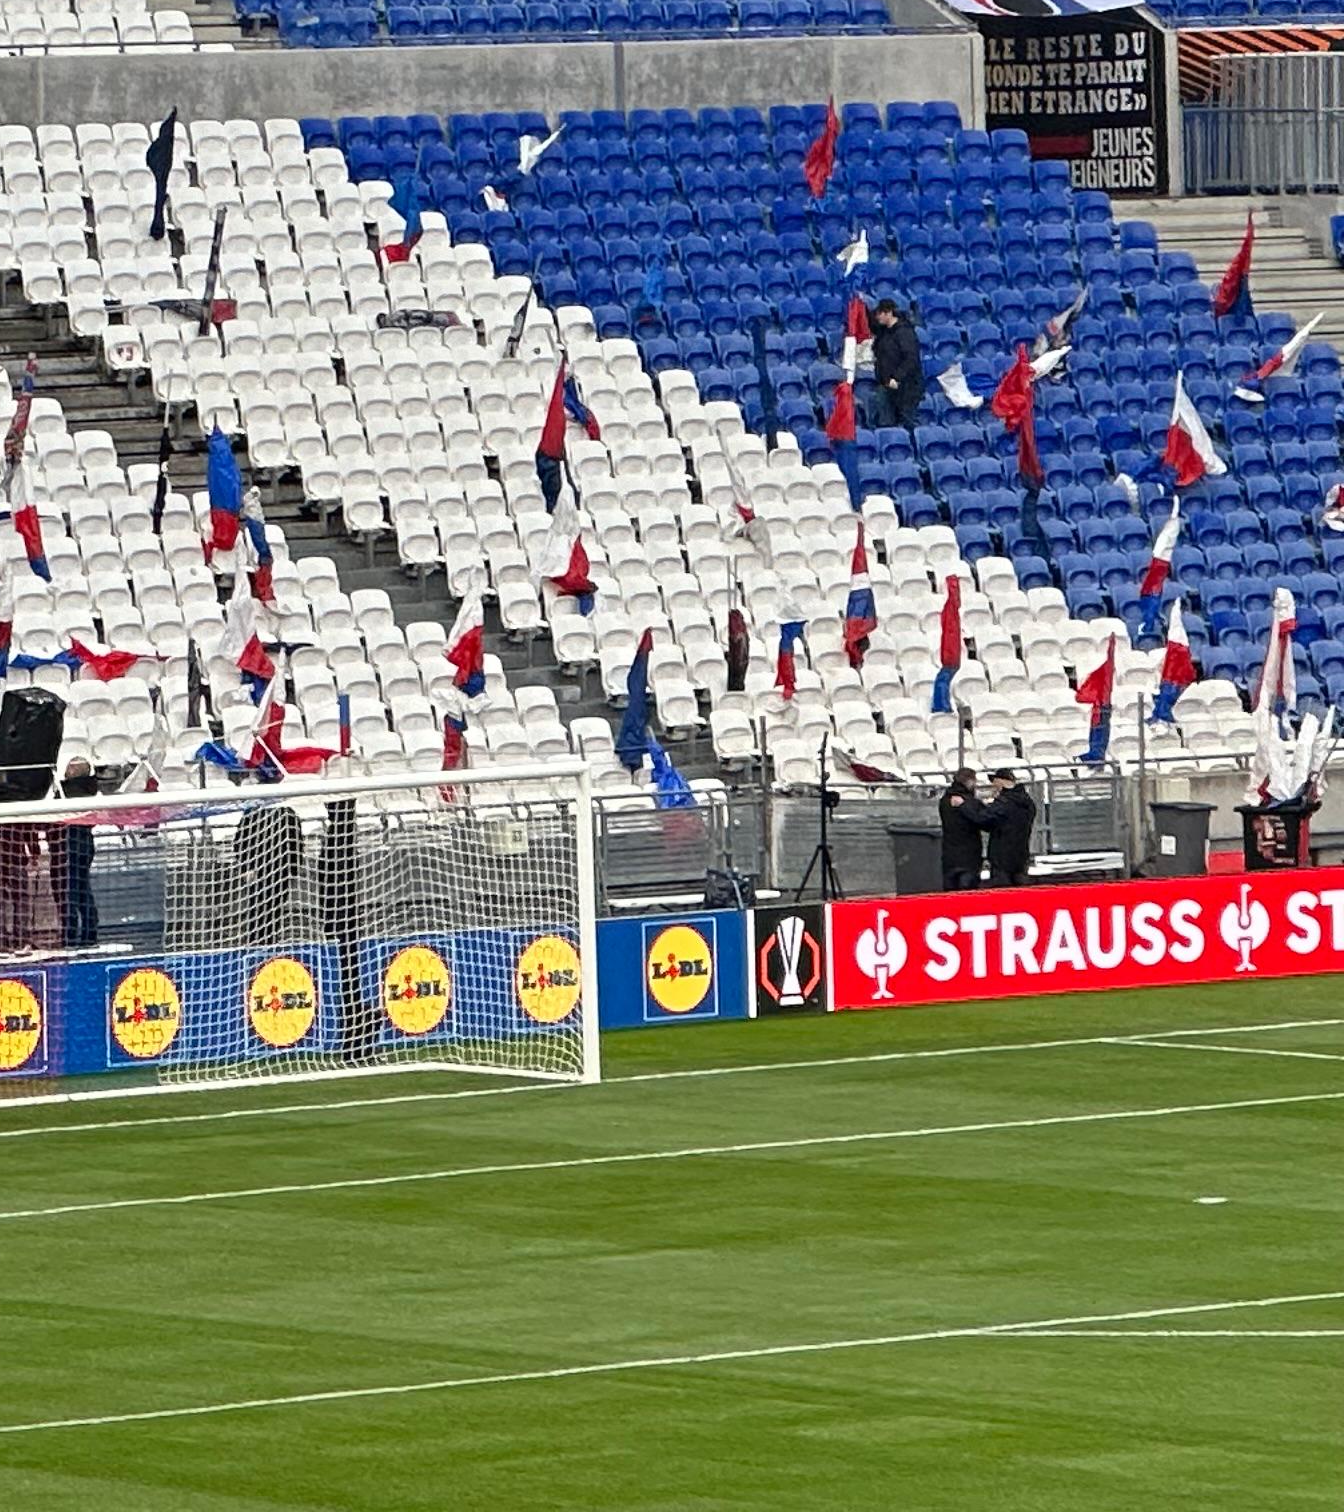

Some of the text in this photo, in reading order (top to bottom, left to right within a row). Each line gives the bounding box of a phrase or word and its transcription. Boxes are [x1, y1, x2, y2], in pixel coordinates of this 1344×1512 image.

[988, 31, 1146, 62] LE RESTE DU
[1045, 62, 1073, 87] TE
[1073, 58, 1148, 85] PARAIT
[1091, 126, 1154, 158] JEUNES
[923, 898, 1206, 982] STRAUSS
